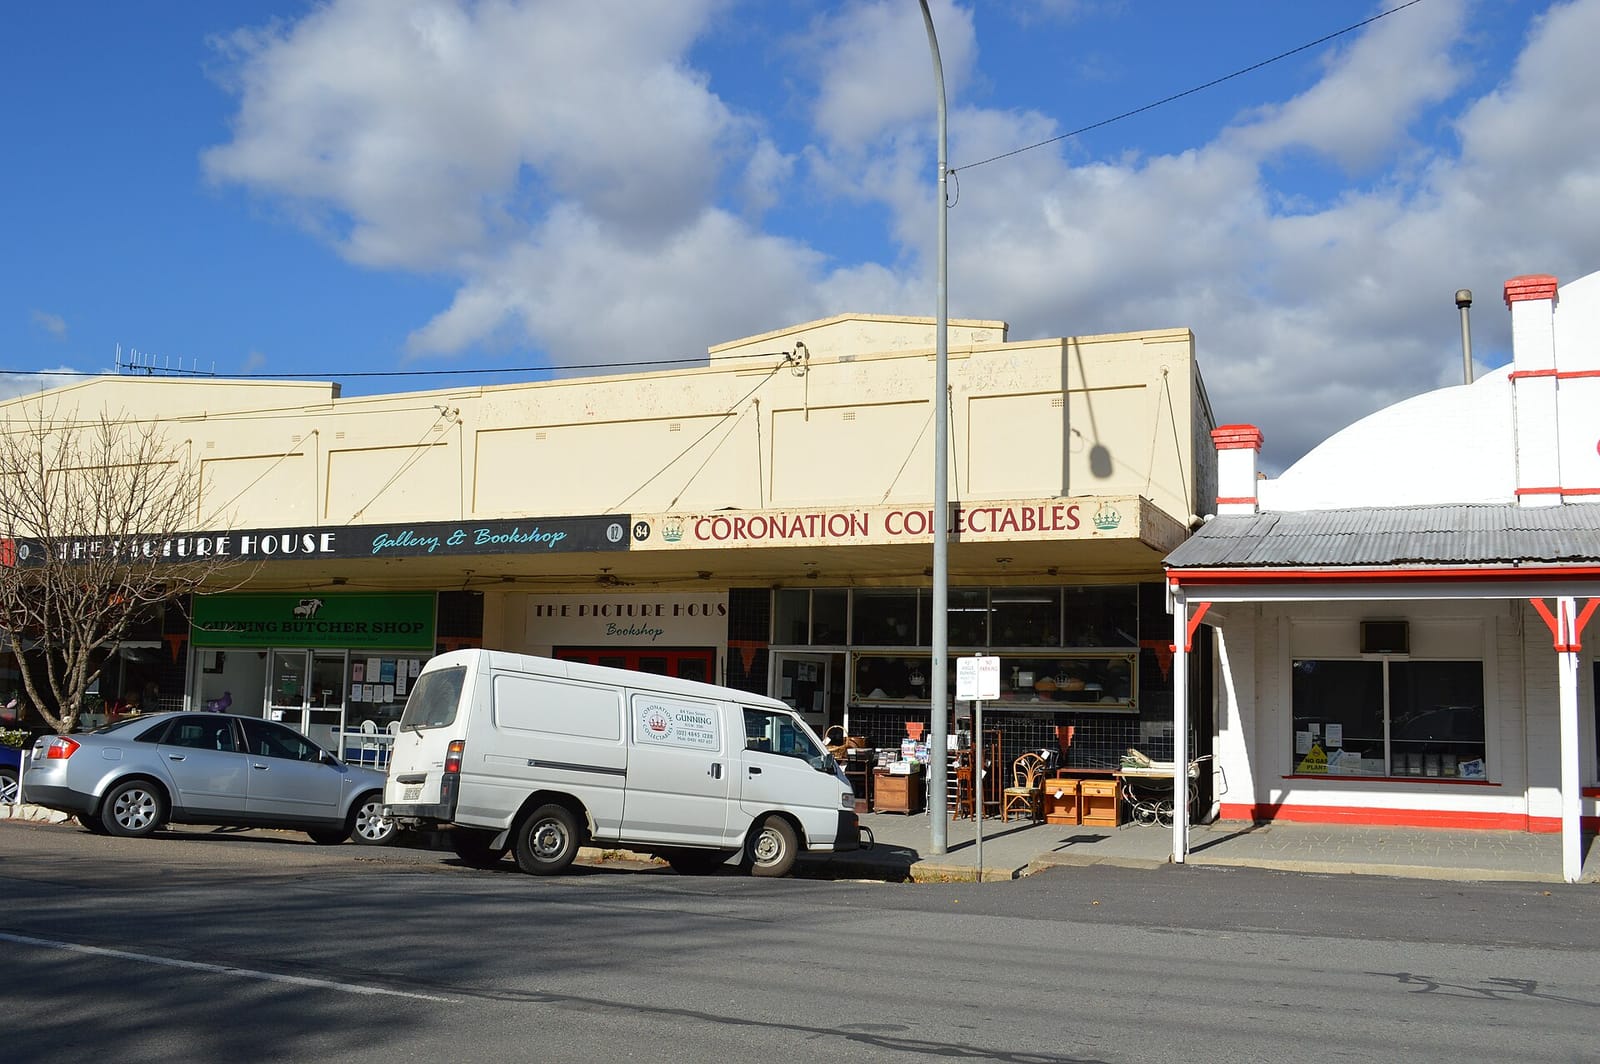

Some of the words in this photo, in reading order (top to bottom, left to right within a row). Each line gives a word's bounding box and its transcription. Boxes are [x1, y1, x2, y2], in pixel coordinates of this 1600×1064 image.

[695, 513, 869, 541] CORONATION
[885, 505, 1080, 537] COLECTABLES
[635, 525, 648, 538] 84
[240, 532, 336, 555] HOUSE
[372, 529, 440, 555] Gallery
[446, 529, 467, 546] &
[474, 527, 567, 548] Bookshop
[535, 604, 571, 618] THE
[578, 604, 664, 618] PICTURE
[282, 621, 368, 633] BUTCHER
[372, 622, 424, 633] SHOP
[606, 623, 664, 641] Bookshop
[675, 714, 712, 725] GUNNING
[643, 724, 673, 740] COLLECTABLES
